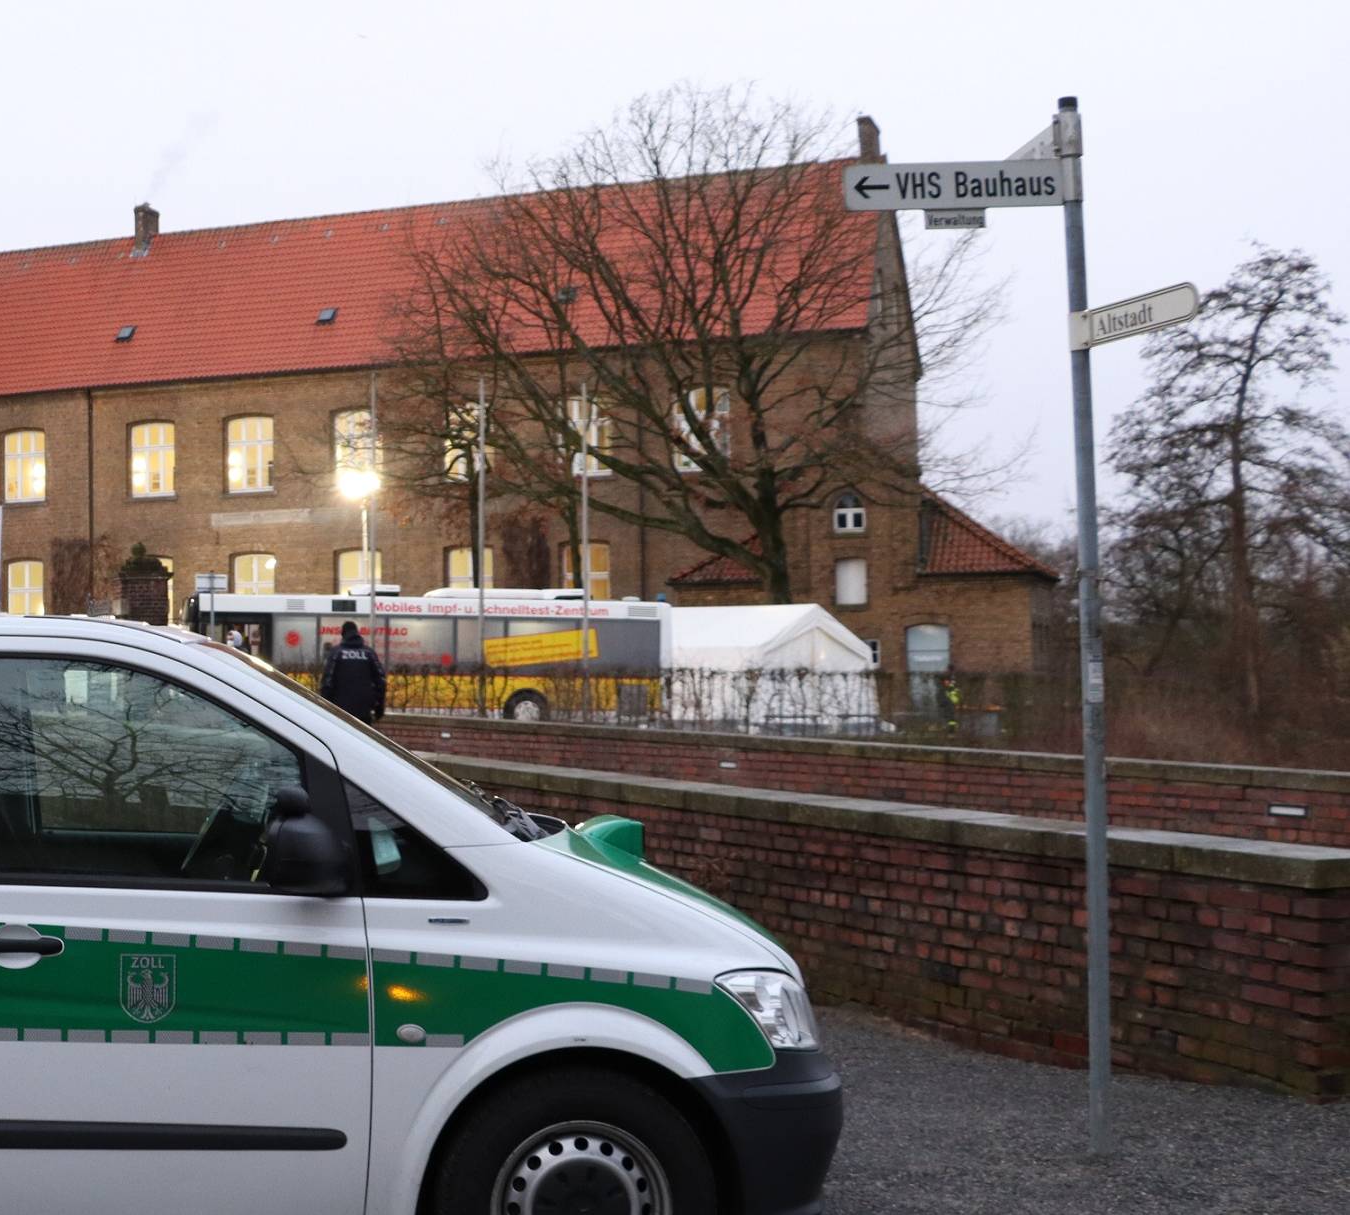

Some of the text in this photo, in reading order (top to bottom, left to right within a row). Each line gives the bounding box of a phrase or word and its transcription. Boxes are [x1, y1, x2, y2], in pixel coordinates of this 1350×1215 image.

[895, 169, 1056, 199] VHS Bauhaus
[927, 213, 985, 228] Verwaltung
[1096, 303, 1153, 336] Altstadt
[373, 602, 422, 613] Mobiles
[341, 649, 368, 660] ZOLL
[130, 956, 165, 969] ZOLL
